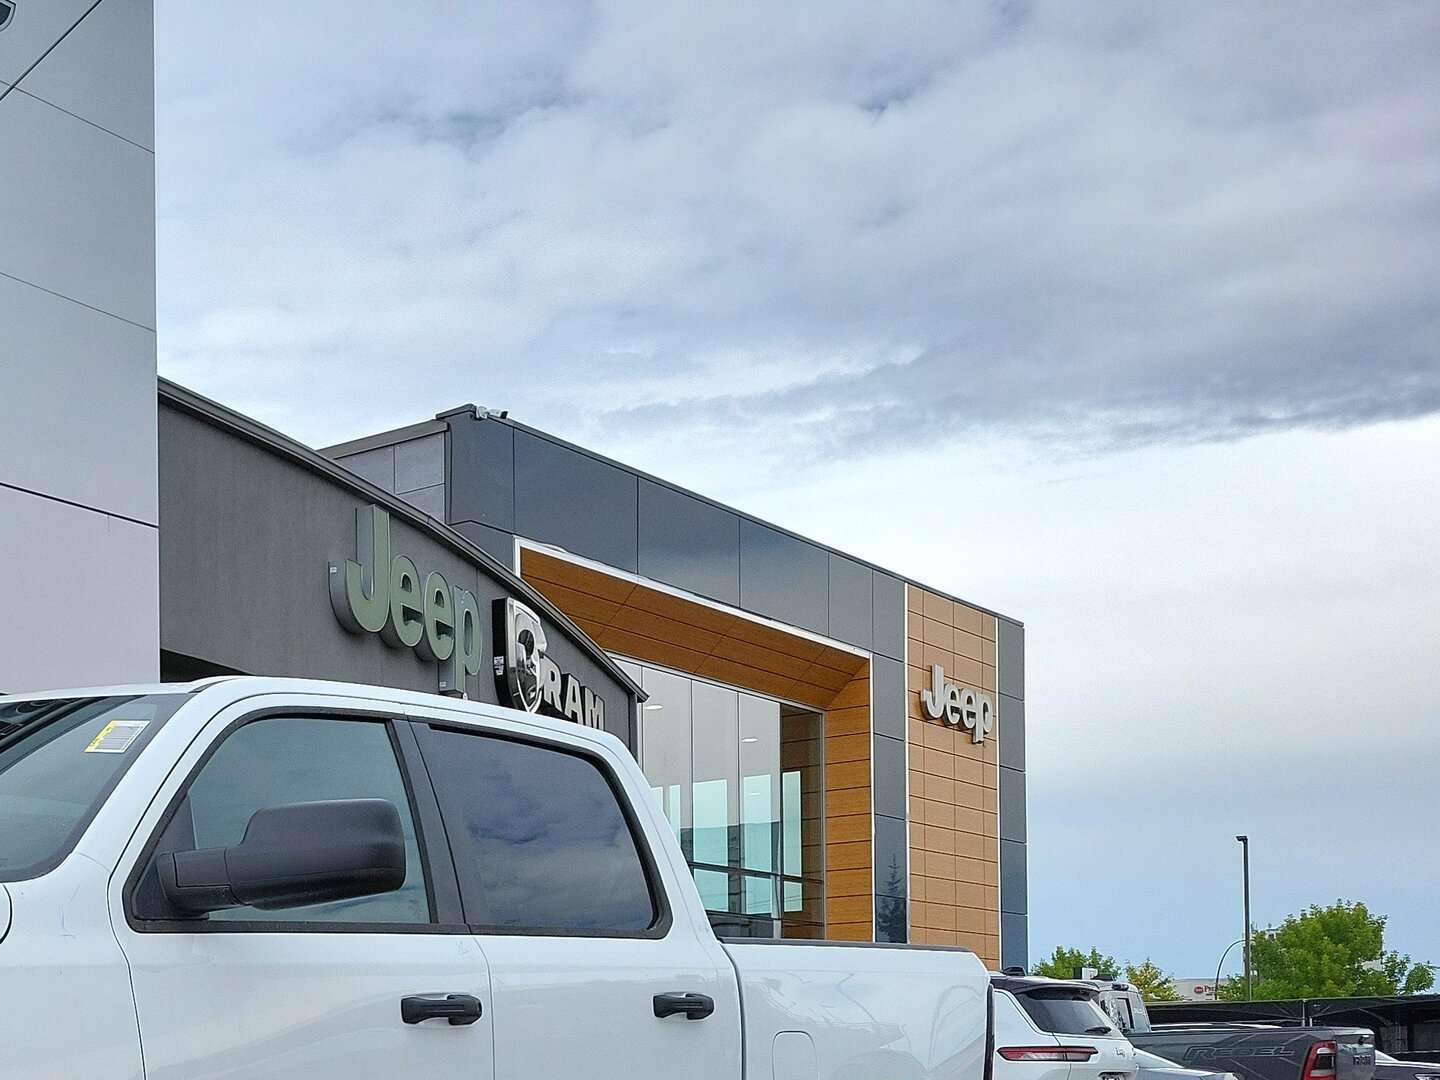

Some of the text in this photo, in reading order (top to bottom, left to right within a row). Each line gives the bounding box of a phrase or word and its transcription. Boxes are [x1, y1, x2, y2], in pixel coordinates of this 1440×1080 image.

[328, 503, 483, 694] Jeep
[539, 653, 606, 731] RAM
[920, 664, 993, 744] Jeep
